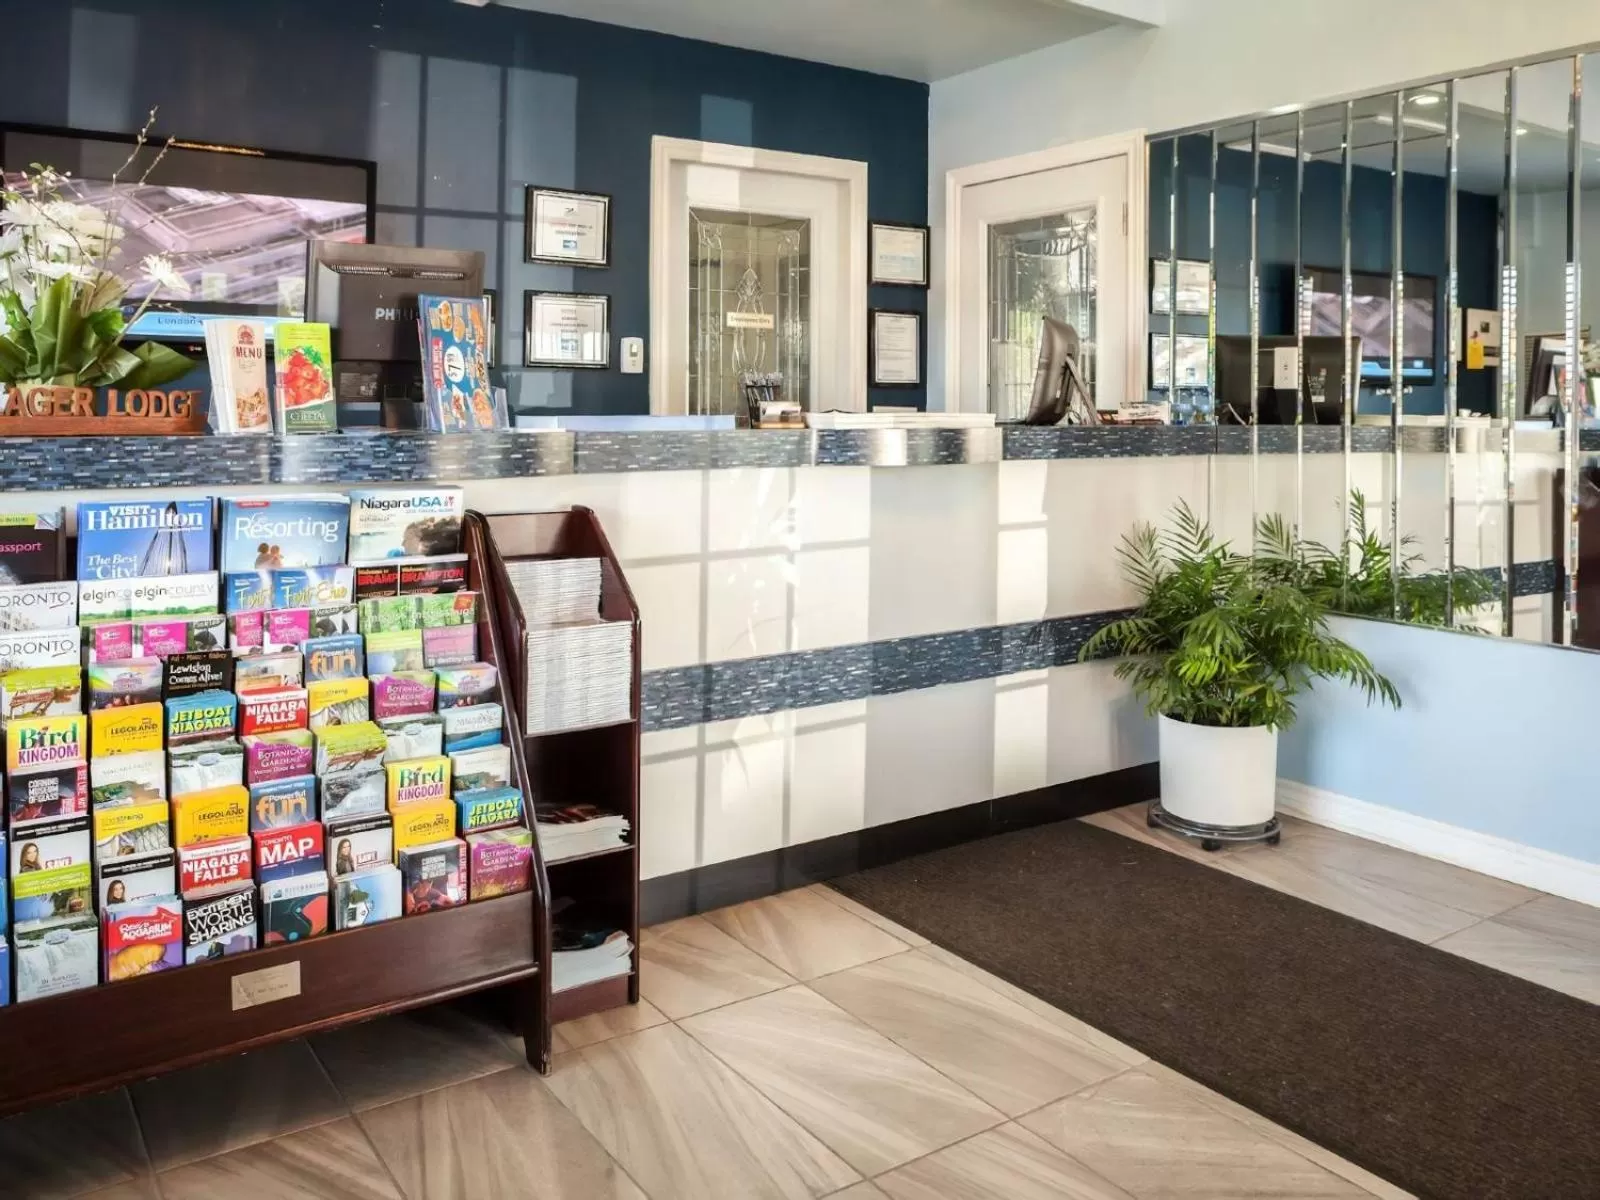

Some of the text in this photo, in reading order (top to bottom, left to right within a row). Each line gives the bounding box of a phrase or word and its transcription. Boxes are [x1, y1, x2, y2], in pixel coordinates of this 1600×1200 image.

[235, 346, 263, 359] MENU
[86, 507, 203, 531] Hamilton
[109, 505, 149, 516] VISIT
[235, 516, 340, 542] Resorting
[402, 567, 465, 584] BRAMPTON
[170, 661, 212, 674] Lewiston
[171, 704, 233, 724] JETBOAT
[245, 699, 307, 716] NIAGARA
[170, 716, 231, 734] NIAGARA
[256, 711, 297, 726] FALLS
[20, 722, 78, 749] Bird
[110, 723, 159, 736] LEGOLAND
[18, 744, 79, 765] KINGDOM
[400, 764, 444, 788] Bird
[398, 783, 444, 801] KINGDOM
[198, 807, 245, 821] LEGOLAND
[255, 795, 307, 826] fun
[470, 797, 519, 817] JETBOAT
[468, 809, 519, 827] NIAGARA
[259, 837, 314, 867] MAP
[182, 851, 249, 874] NIAGARA
[193, 864, 239, 883] FALLS
[186, 892, 252, 921] EXCITEMENT
[188, 903, 253, 933] WORTH
[122, 921, 173, 941] AQUARIUM
[189, 913, 255, 945] SHARING
